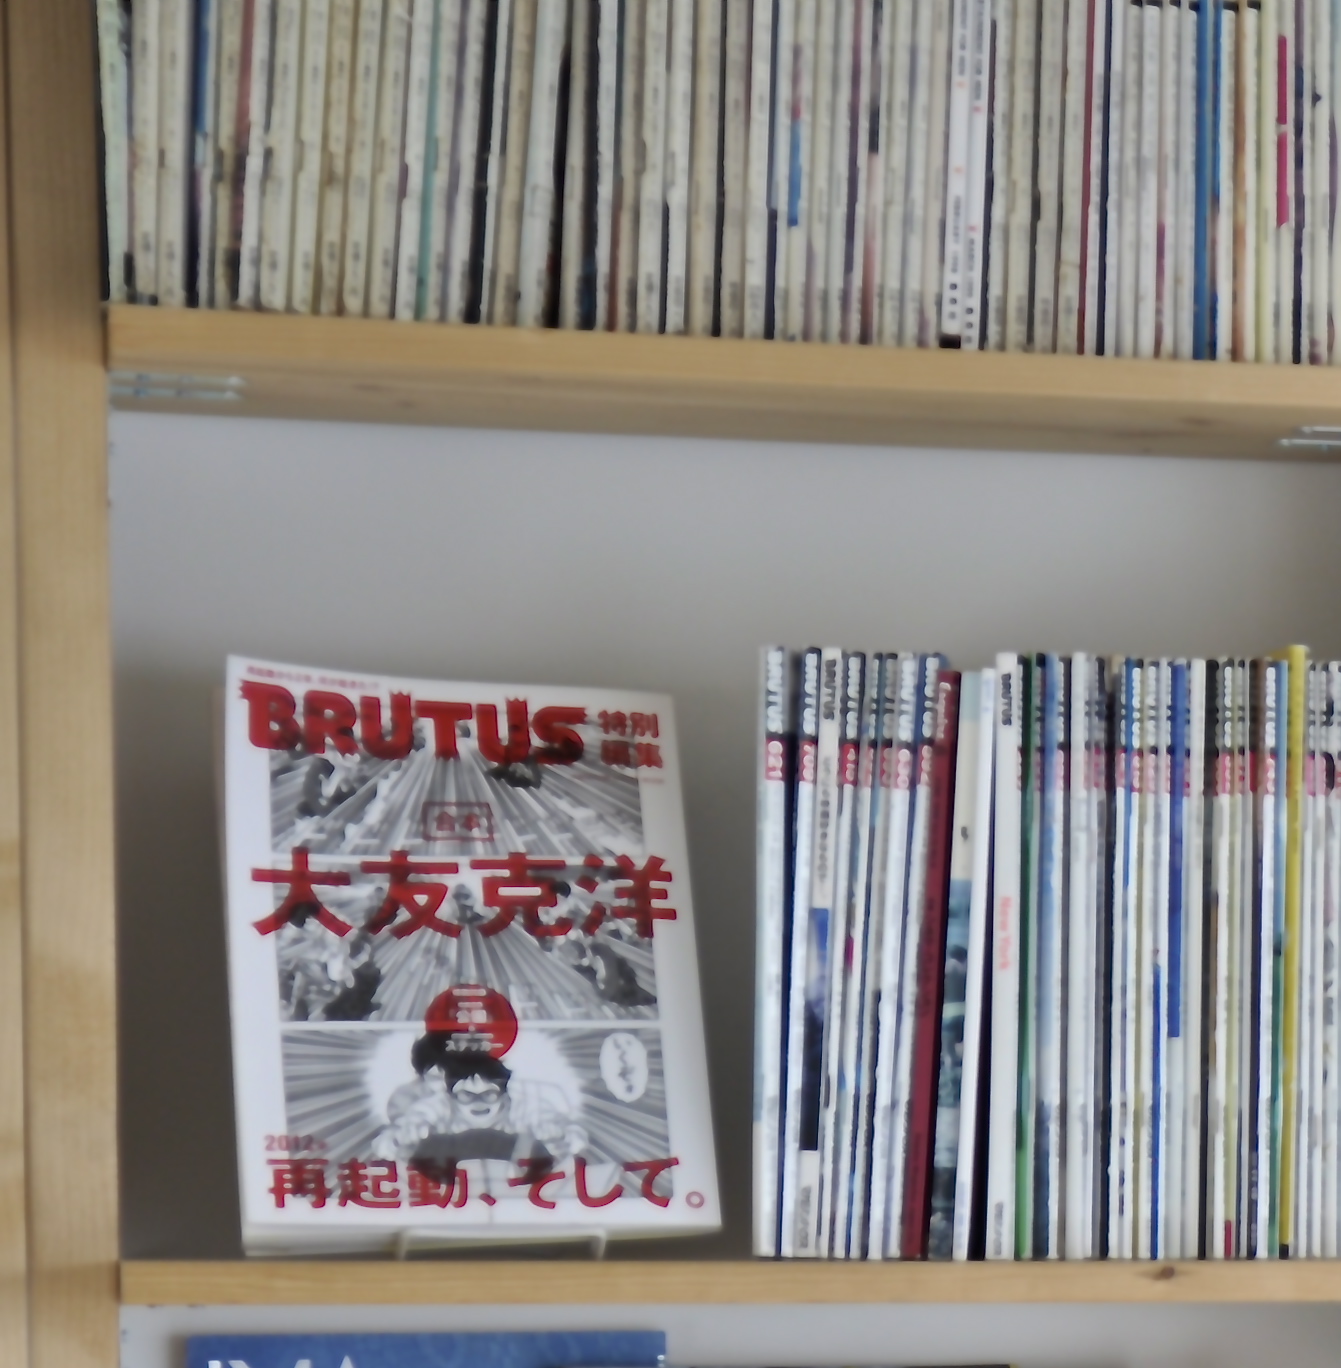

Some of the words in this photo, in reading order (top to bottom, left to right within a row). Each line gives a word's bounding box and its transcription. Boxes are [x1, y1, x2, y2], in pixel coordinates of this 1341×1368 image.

[240, 680, 587, 767] BRUTUS
[767, 650, 783, 735] BRUTUS
[803, 653, 818, 736] BRUTUS
[251, 846, 677, 939] 大友克洋
[267, 1157, 706, 1211] 再起動、そして。
